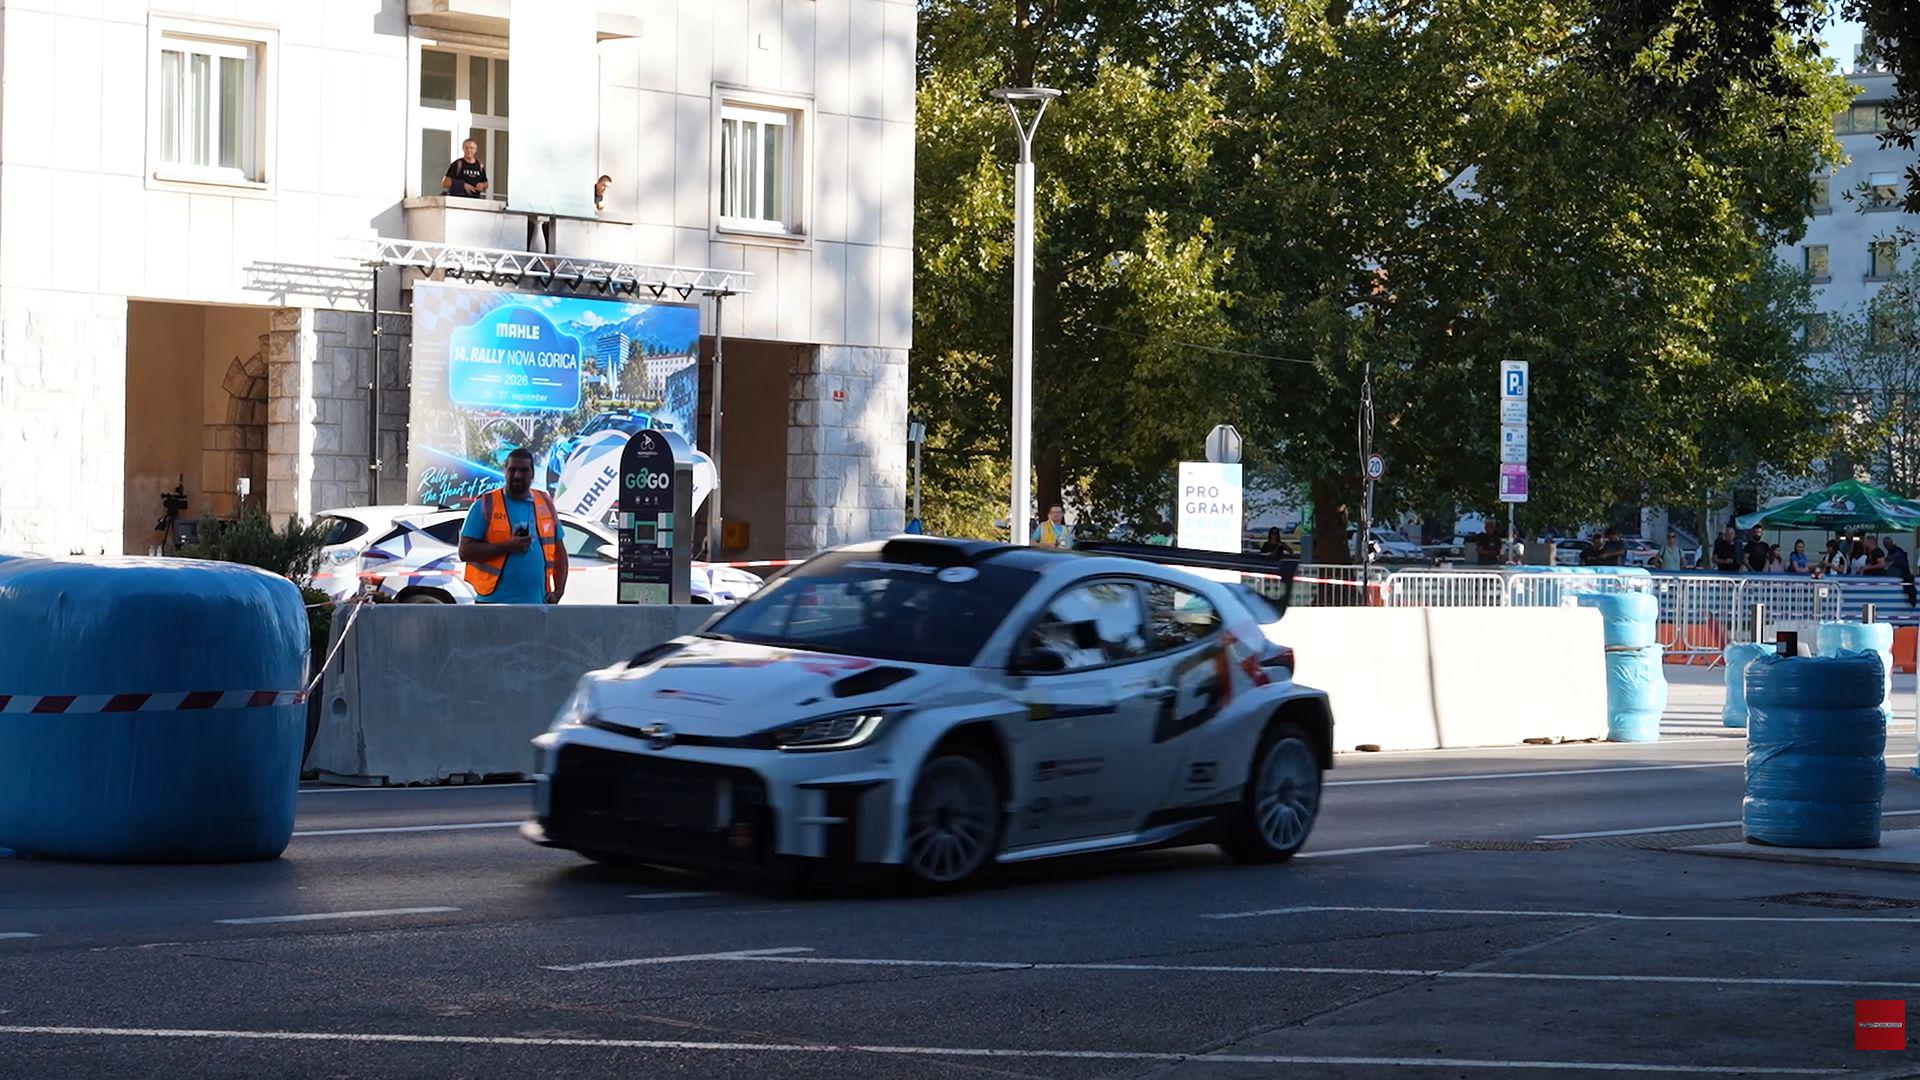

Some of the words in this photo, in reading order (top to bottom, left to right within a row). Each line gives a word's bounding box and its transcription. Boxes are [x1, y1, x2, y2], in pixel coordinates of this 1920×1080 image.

[496, 322, 540, 340] MAHLE
[470, 347, 505, 364] RALLY
[507, 350, 536, 366] NOVA
[537, 352, 577, 369] GORICA
[1509, 372, 1519, 392] P
[1369, 460, 1381, 474] 20
[417, 467, 448, 491] Rally
[450, 470, 459, 480] in
[421, 488, 437, 504] the
[439, 480, 469, 504] Heart
[467, 477, 479, 498] of
[1185, 485, 1219, 498] PRO
[1185, 502, 1234, 514] GRAM
